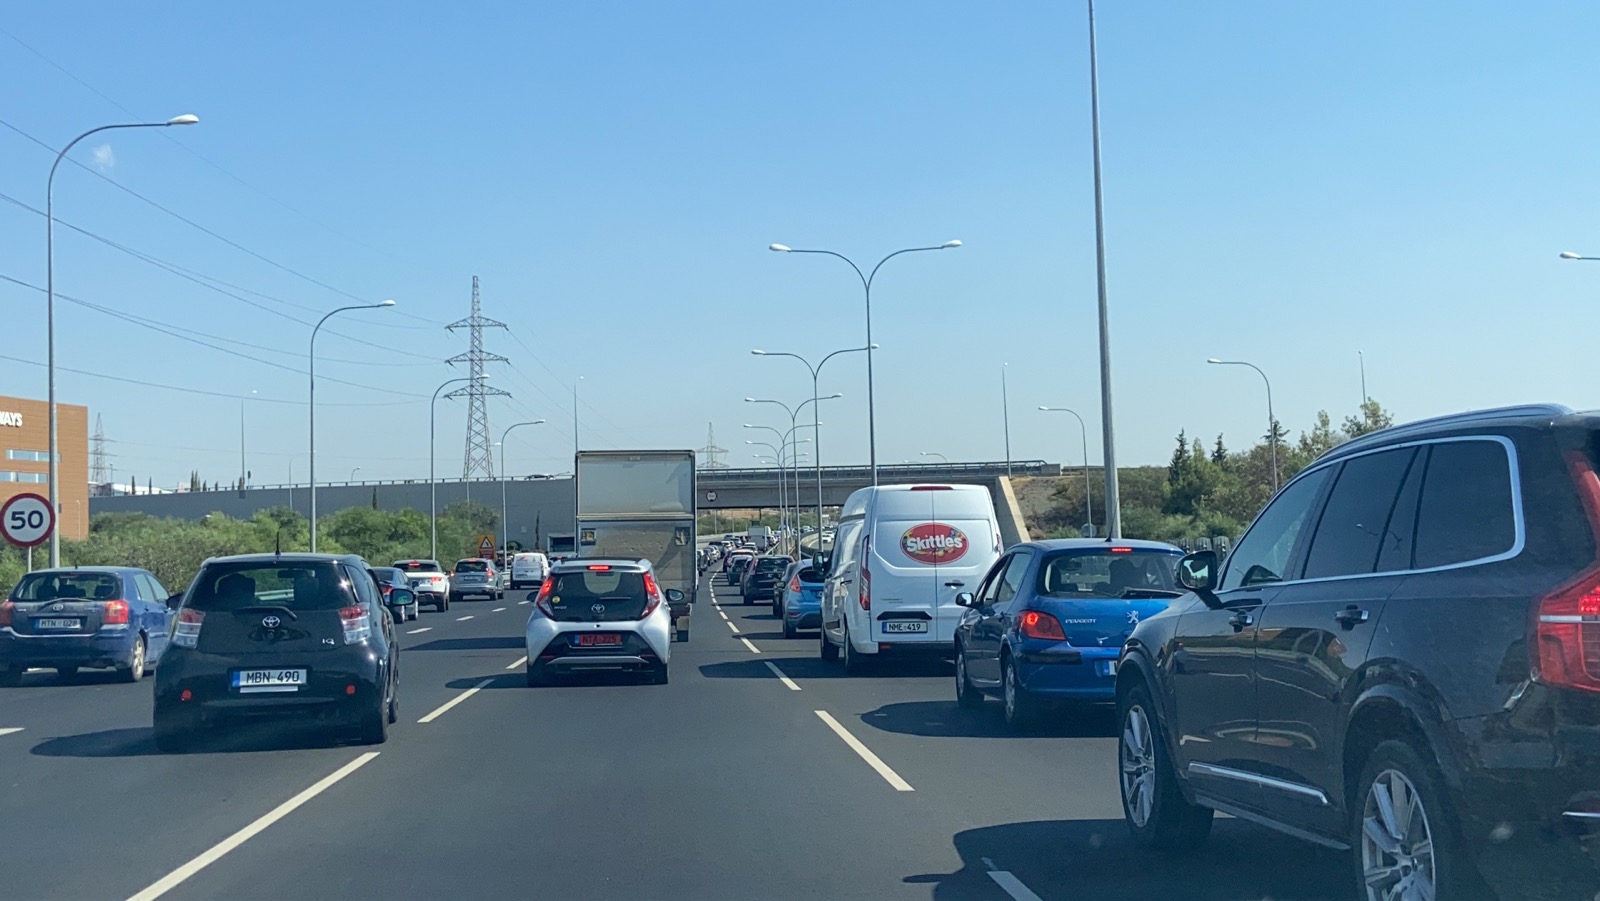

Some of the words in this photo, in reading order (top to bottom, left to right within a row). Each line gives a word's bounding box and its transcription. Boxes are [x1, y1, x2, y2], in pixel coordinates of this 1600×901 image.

[10, 510, 44, 530] 50
[906, 534, 963, 552] Skittles
[888, 623, 903, 631] NME
[907, 623, 921, 631] 419
[246, 671, 271, 684] MBN
[277, 670, 300, 682] 490
